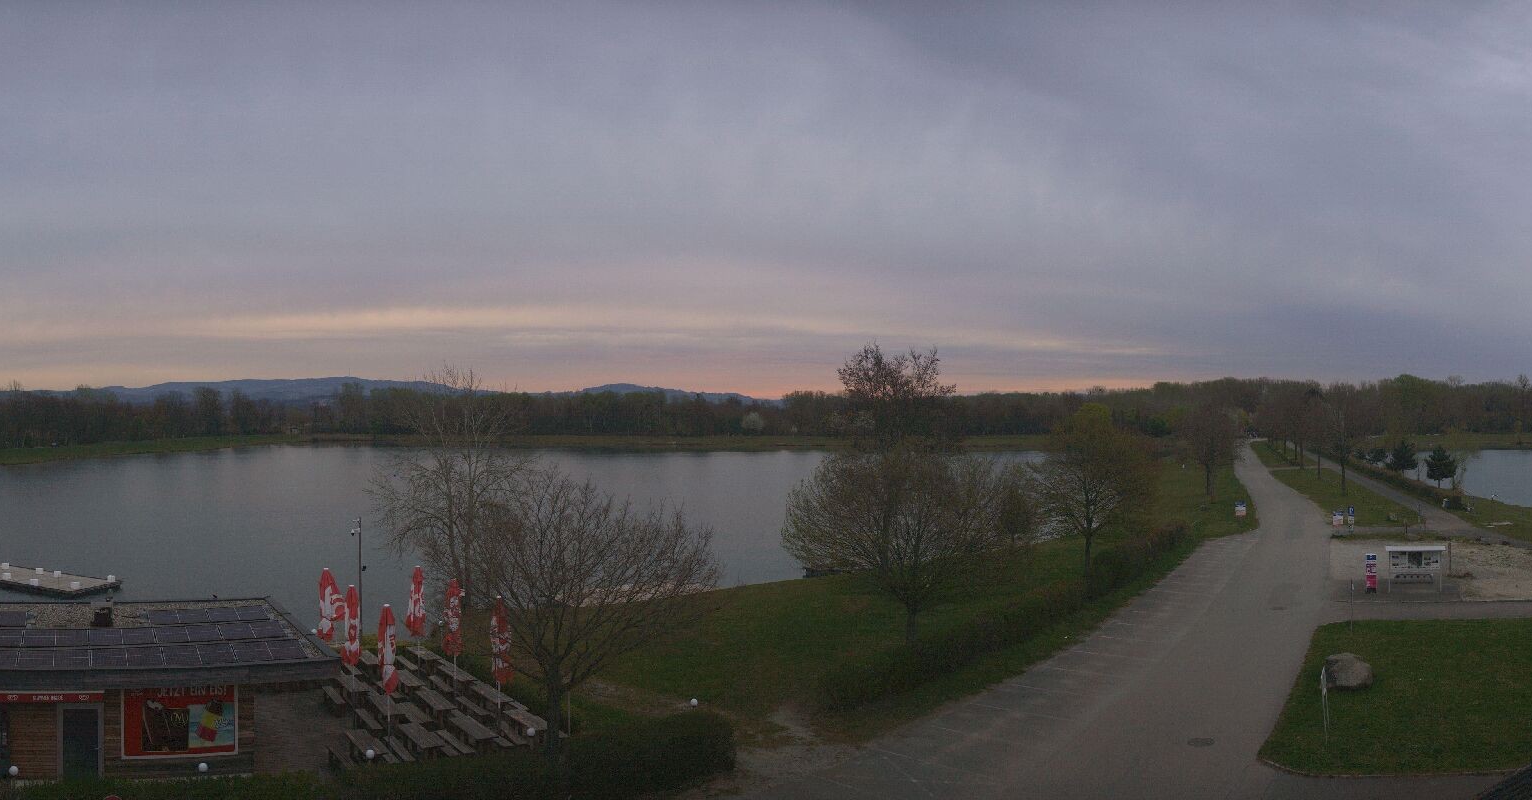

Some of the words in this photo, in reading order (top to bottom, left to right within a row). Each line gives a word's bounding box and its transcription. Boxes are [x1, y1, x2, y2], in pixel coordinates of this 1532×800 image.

[157, 687, 186, 697] JETZT
[190, 686, 206, 696] EIN
[209, 685, 227, 696] EIS!
